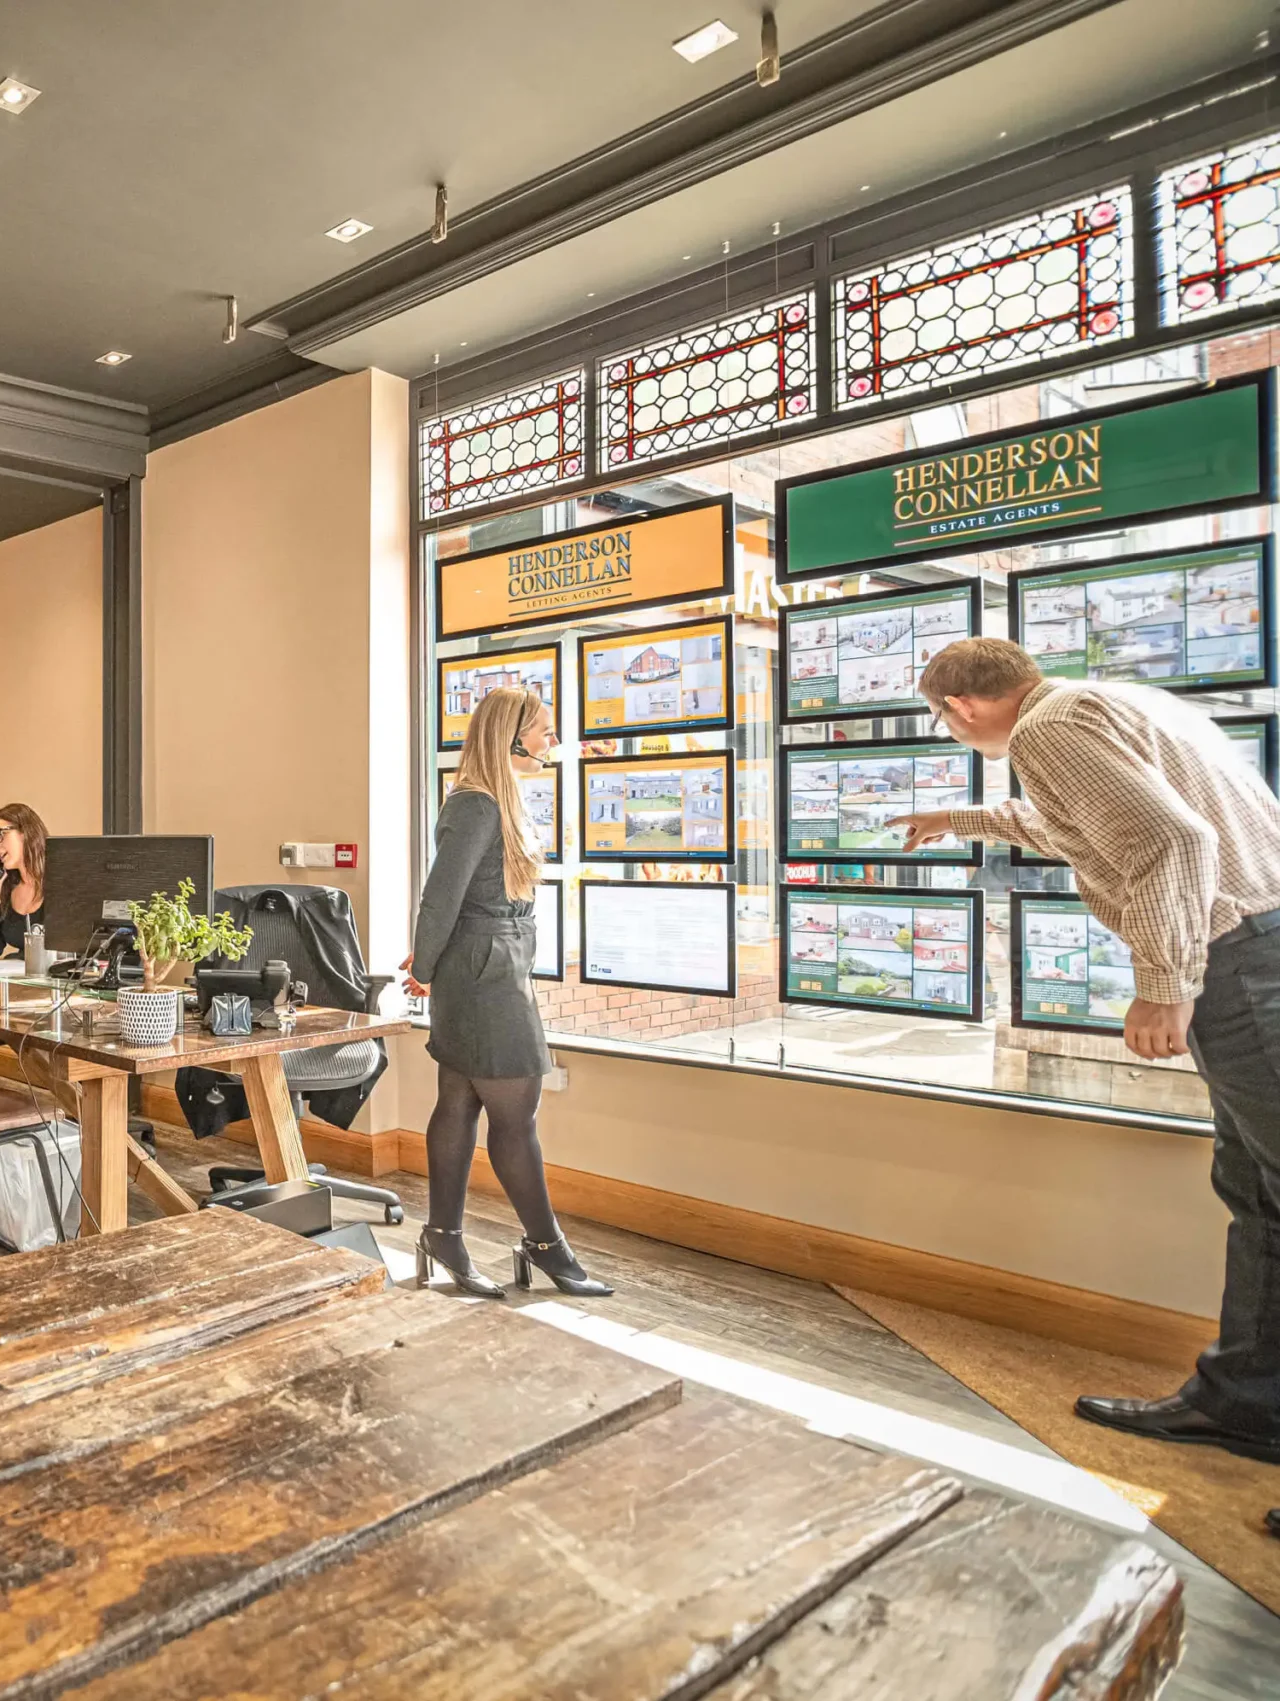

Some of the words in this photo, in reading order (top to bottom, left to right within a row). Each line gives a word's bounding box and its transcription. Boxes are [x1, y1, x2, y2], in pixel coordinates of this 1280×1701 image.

[893, 425, 1101, 494] HENDERSON
[894, 456, 1101, 520] CONNELLAN
[930, 513, 987, 534] ESTATE
[993, 502, 1061, 523] AGENTS
[508, 530, 632, 576] HENDERSON
[508, 554, 632, 597] CONNELLAN
[526, 596, 568, 609] LETTING
[572, 586, 612, 600] AGENTS
